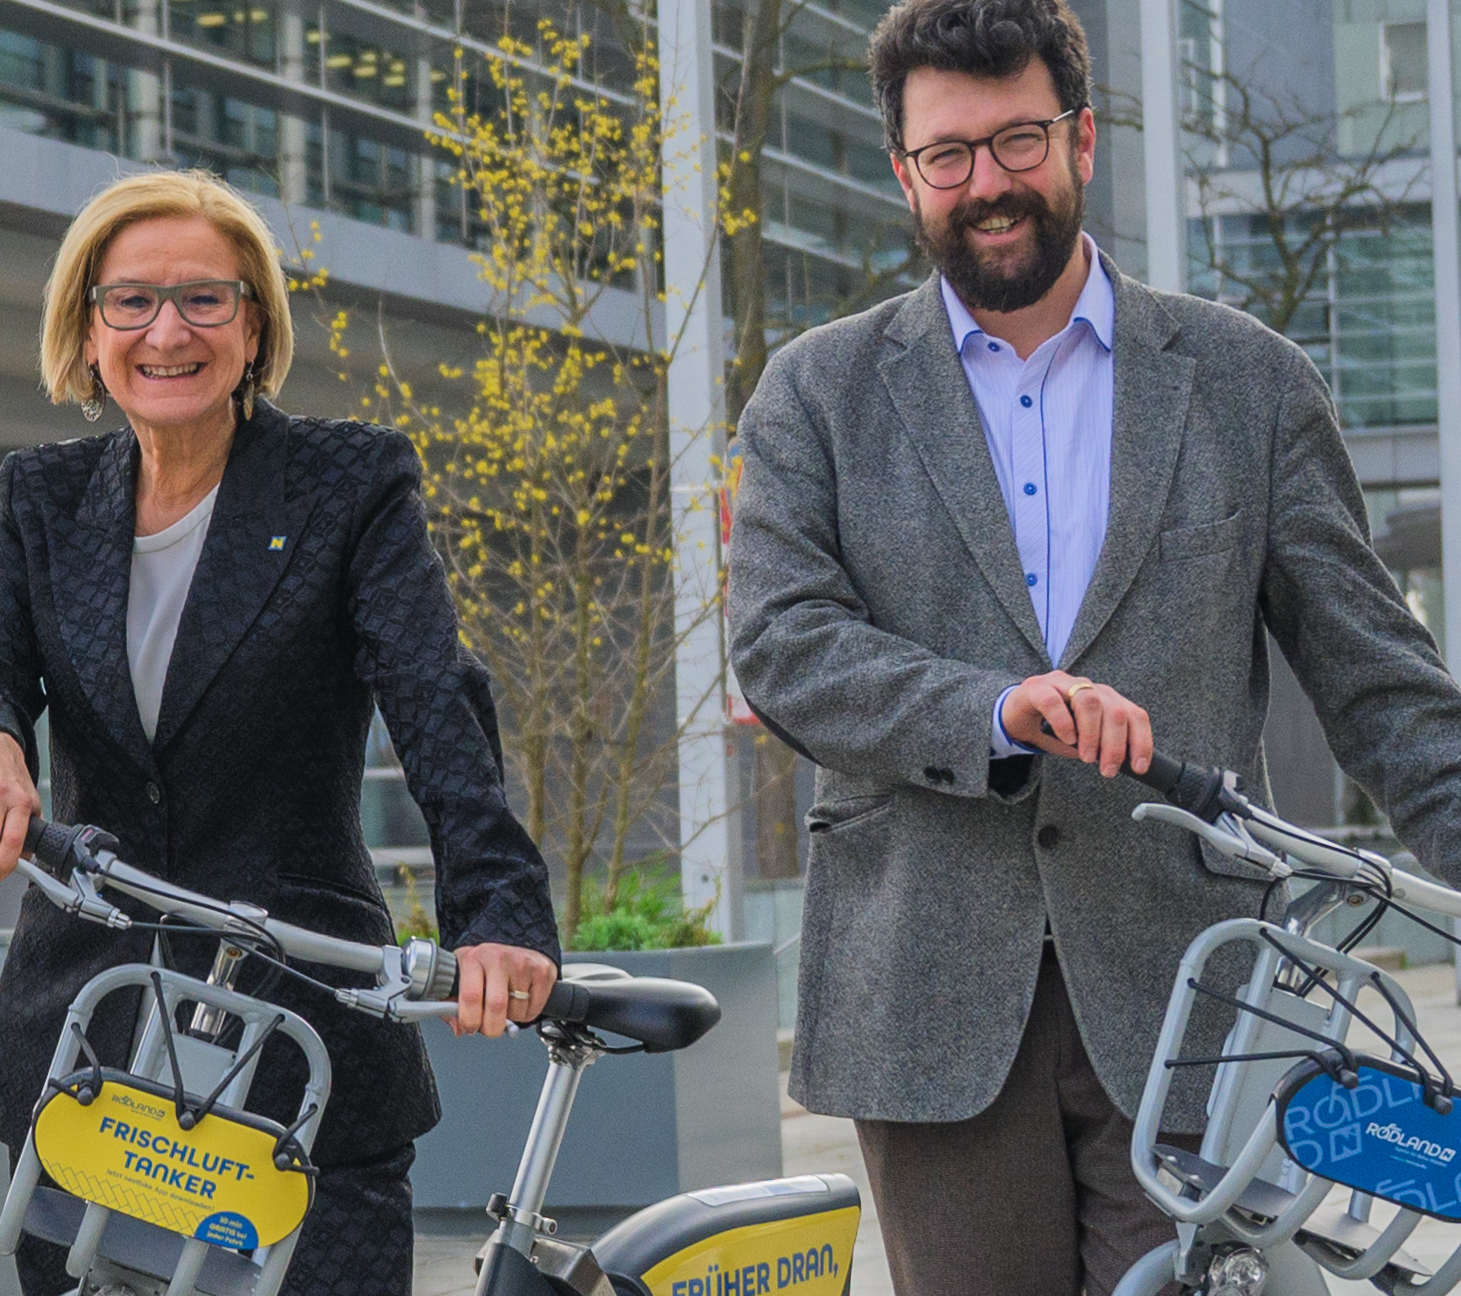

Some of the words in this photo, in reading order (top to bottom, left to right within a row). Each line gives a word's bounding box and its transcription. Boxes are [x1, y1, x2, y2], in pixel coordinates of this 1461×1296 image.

[98, 1116, 255, 1182] FRISCHLUFT-
[124, 1150, 217, 1200] TANKER
[777, 1243, 839, 1289] DRAN,
